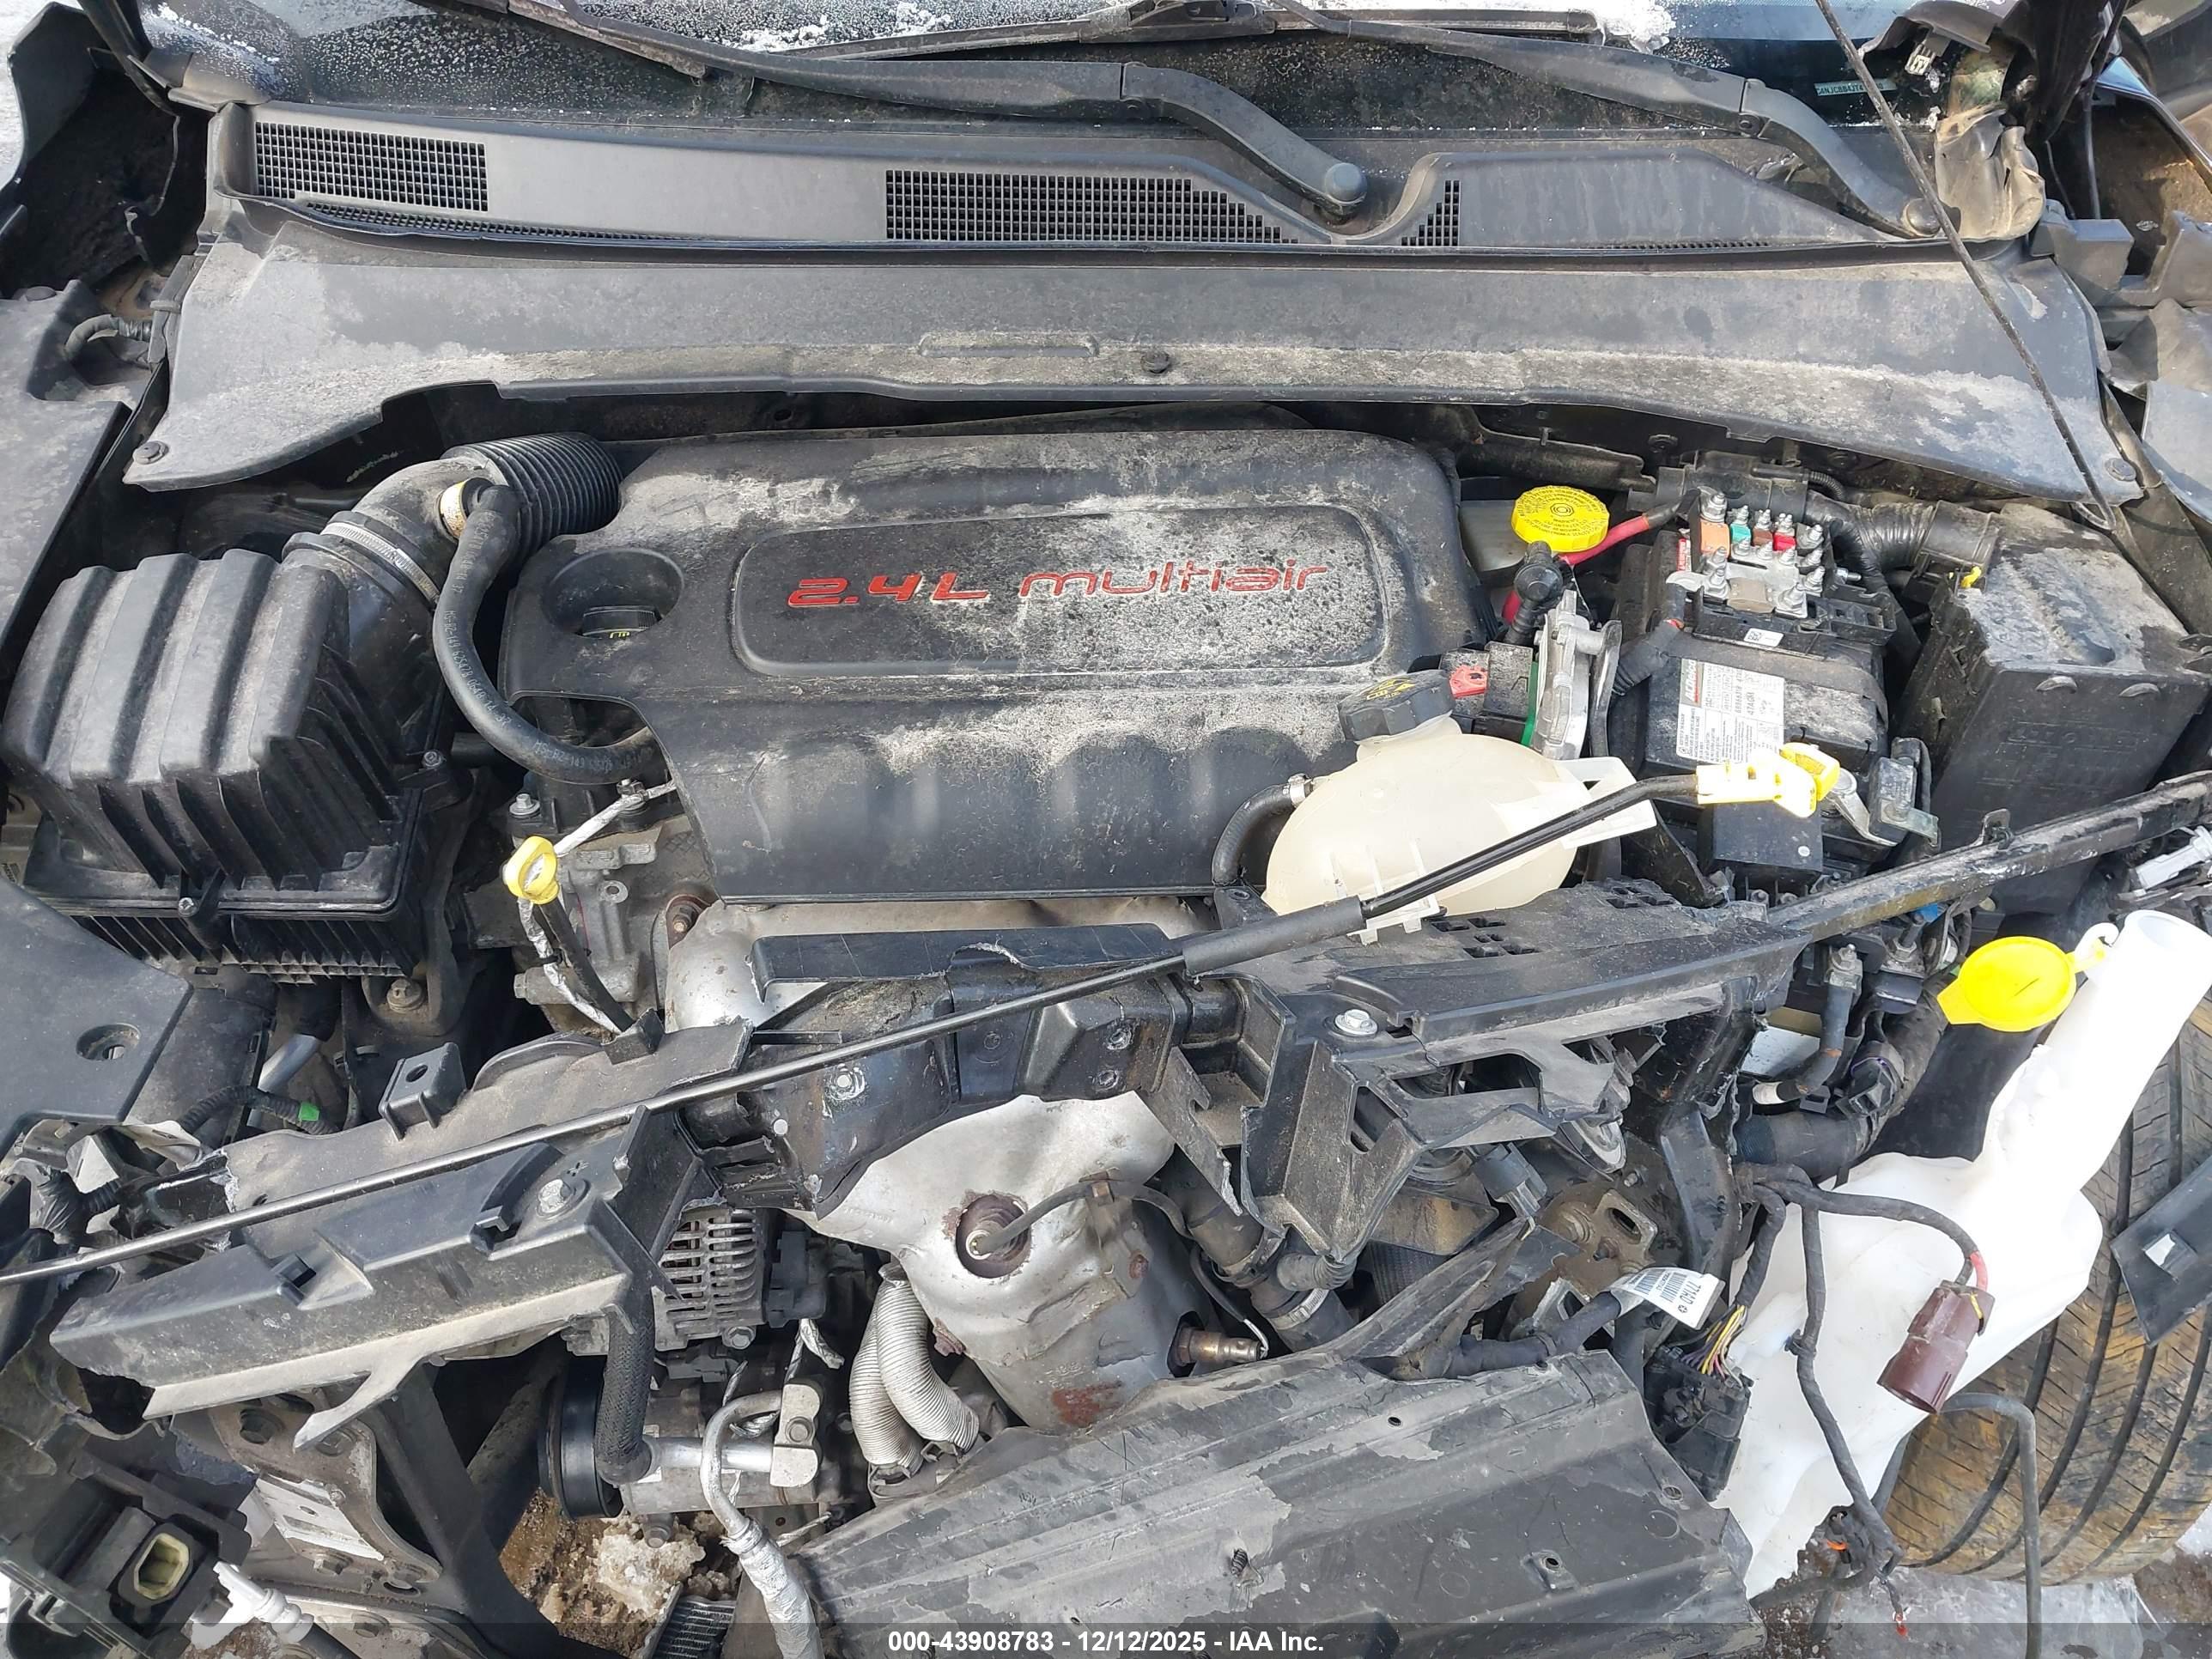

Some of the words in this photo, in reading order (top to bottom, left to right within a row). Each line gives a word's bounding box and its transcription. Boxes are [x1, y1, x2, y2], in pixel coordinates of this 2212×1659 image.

[787, 573, 990, 606] 2.4L
[1021, 559, 1328, 597] multiair
[1685, 659, 1697, 702] ACDelco
